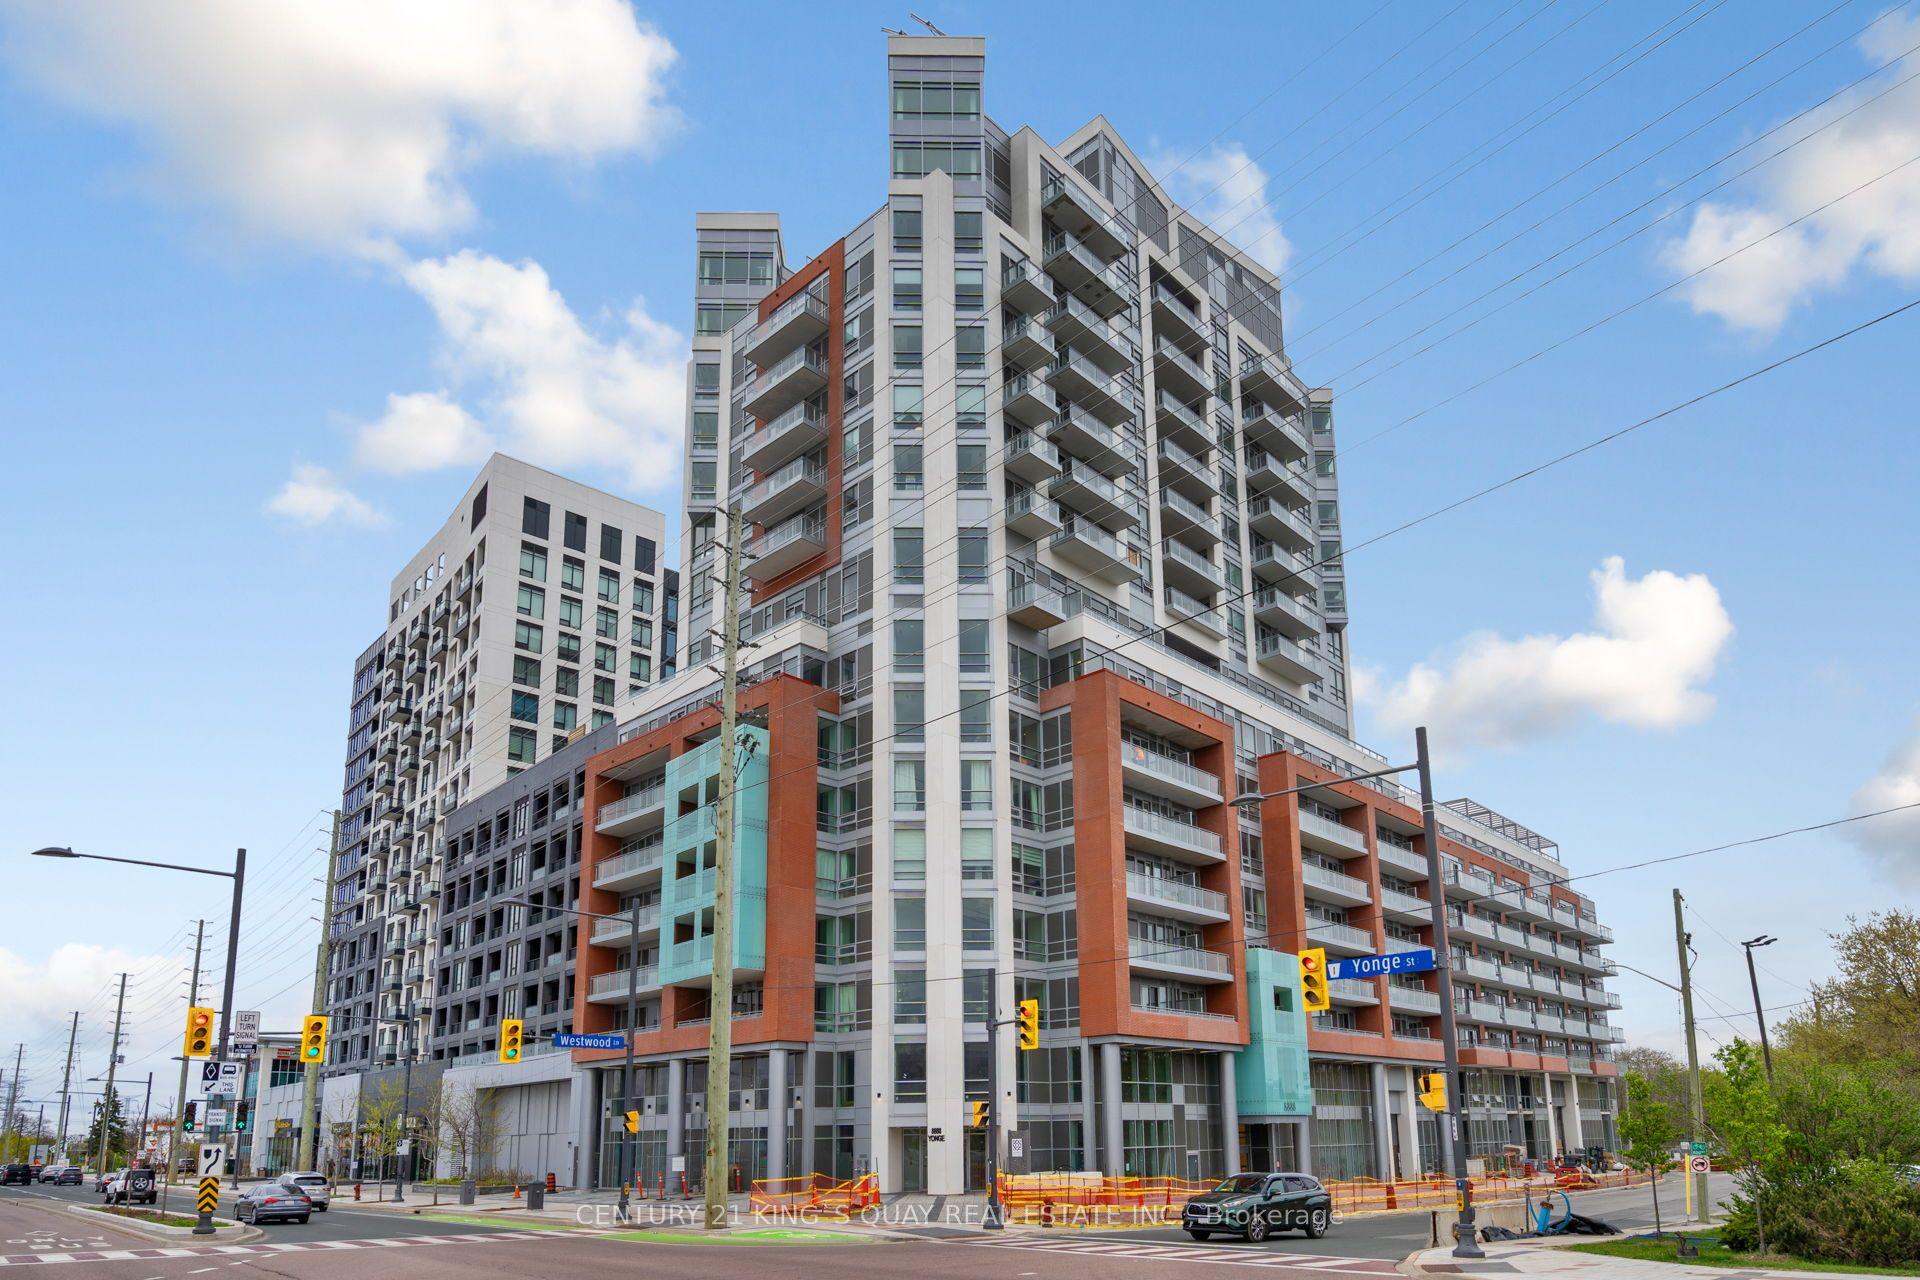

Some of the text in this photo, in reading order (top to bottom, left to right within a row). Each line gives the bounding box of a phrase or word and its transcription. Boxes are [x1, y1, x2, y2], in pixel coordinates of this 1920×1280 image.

[1352, 956, 1401, 974] Yonge
[1406, 957, 1415, 966] St
[240, 1014, 256, 1022] LEFT
[236, 1031, 256, 1039] SIGNAL
[560, 1036, 610, 1047] Westwood
